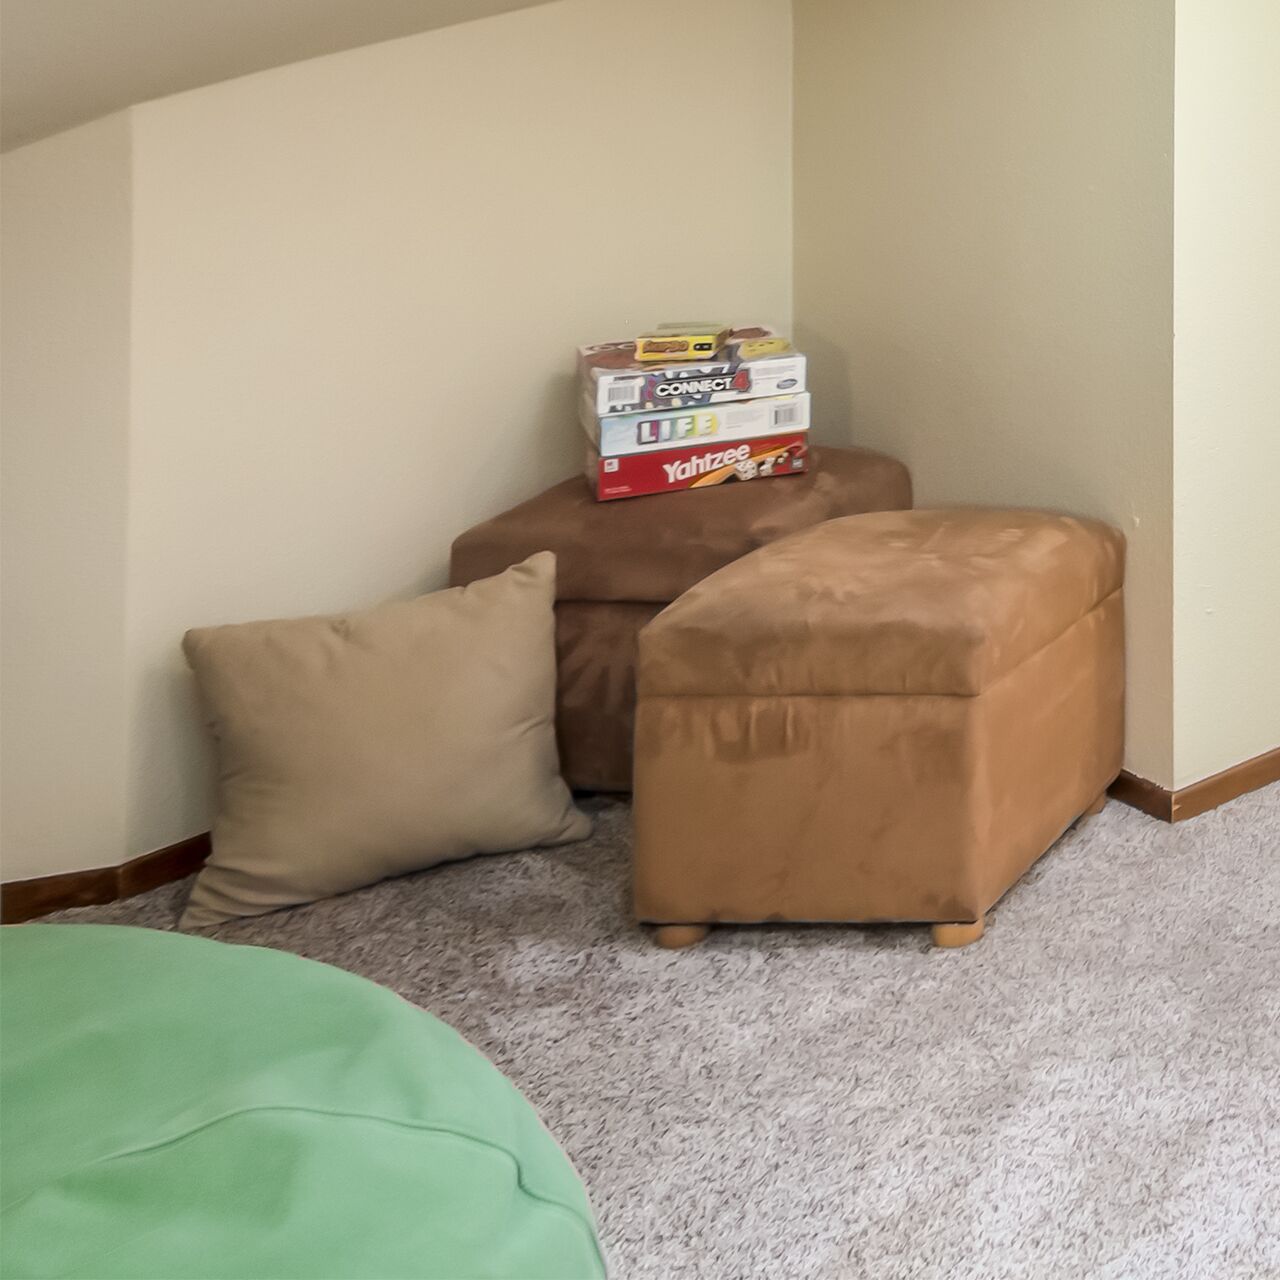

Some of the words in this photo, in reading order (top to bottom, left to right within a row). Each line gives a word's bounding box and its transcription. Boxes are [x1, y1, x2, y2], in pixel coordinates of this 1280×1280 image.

[656, 377, 733, 397] CONNECT
[732, 370, 750, 392] 4
[638, 414, 716, 445] LIFE
[662, 444, 751, 484] Yahtzee
